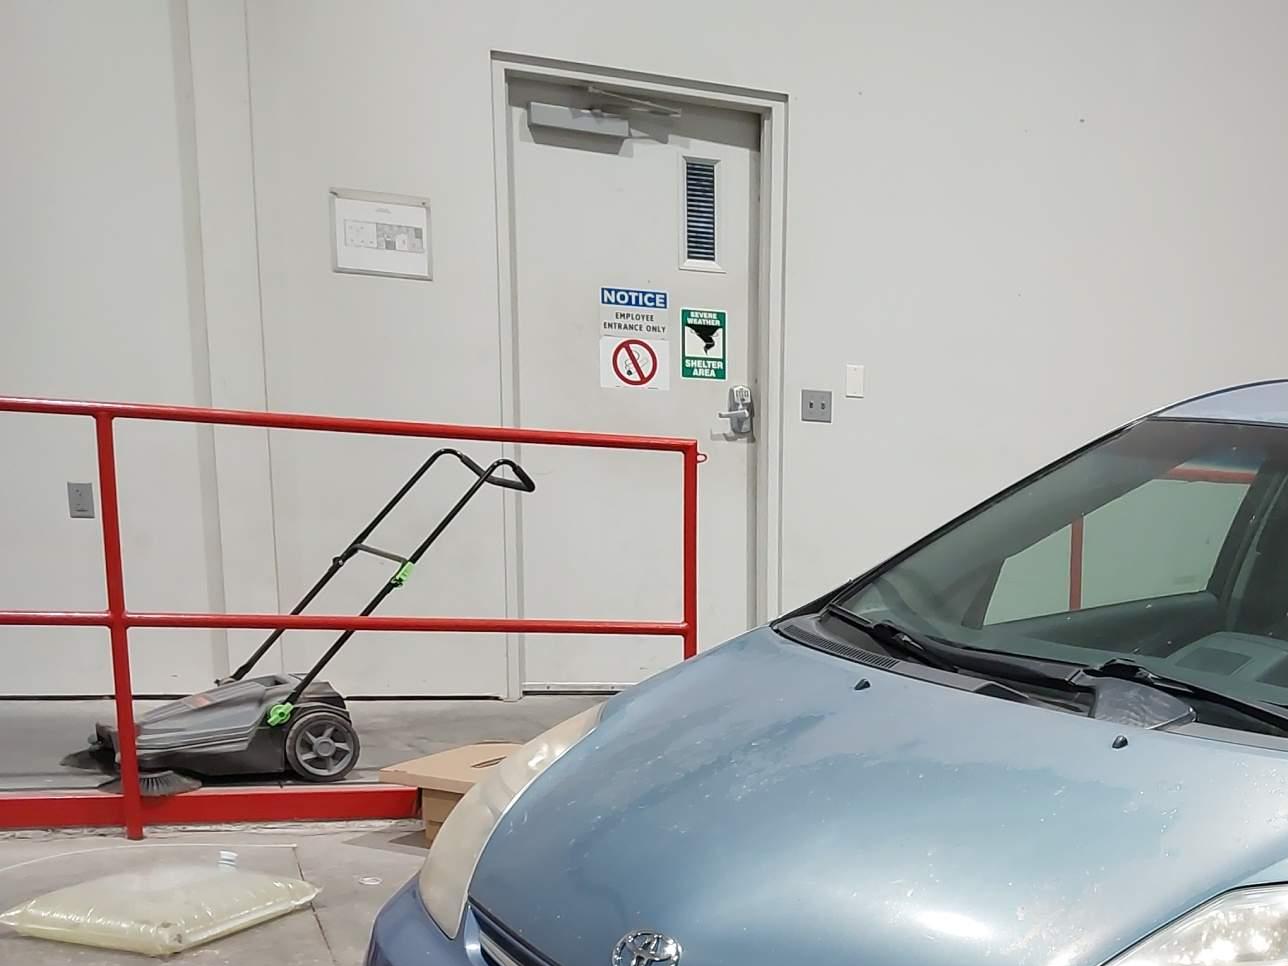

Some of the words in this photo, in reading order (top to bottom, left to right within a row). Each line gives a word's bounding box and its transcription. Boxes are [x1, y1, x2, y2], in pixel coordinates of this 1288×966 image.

[603, 289, 666, 307] NOTICE
[615, 312, 655, 322] EMPLOYEE
[690, 311, 718, 319] SEVERE
[603, 321, 643, 331] ENTRANCE
[646, 324, 666, 333] ONLY
[687, 318, 721, 326] WEATHER
[685, 359, 723, 369] SHELTER
[692, 368, 716, 377] AREA
